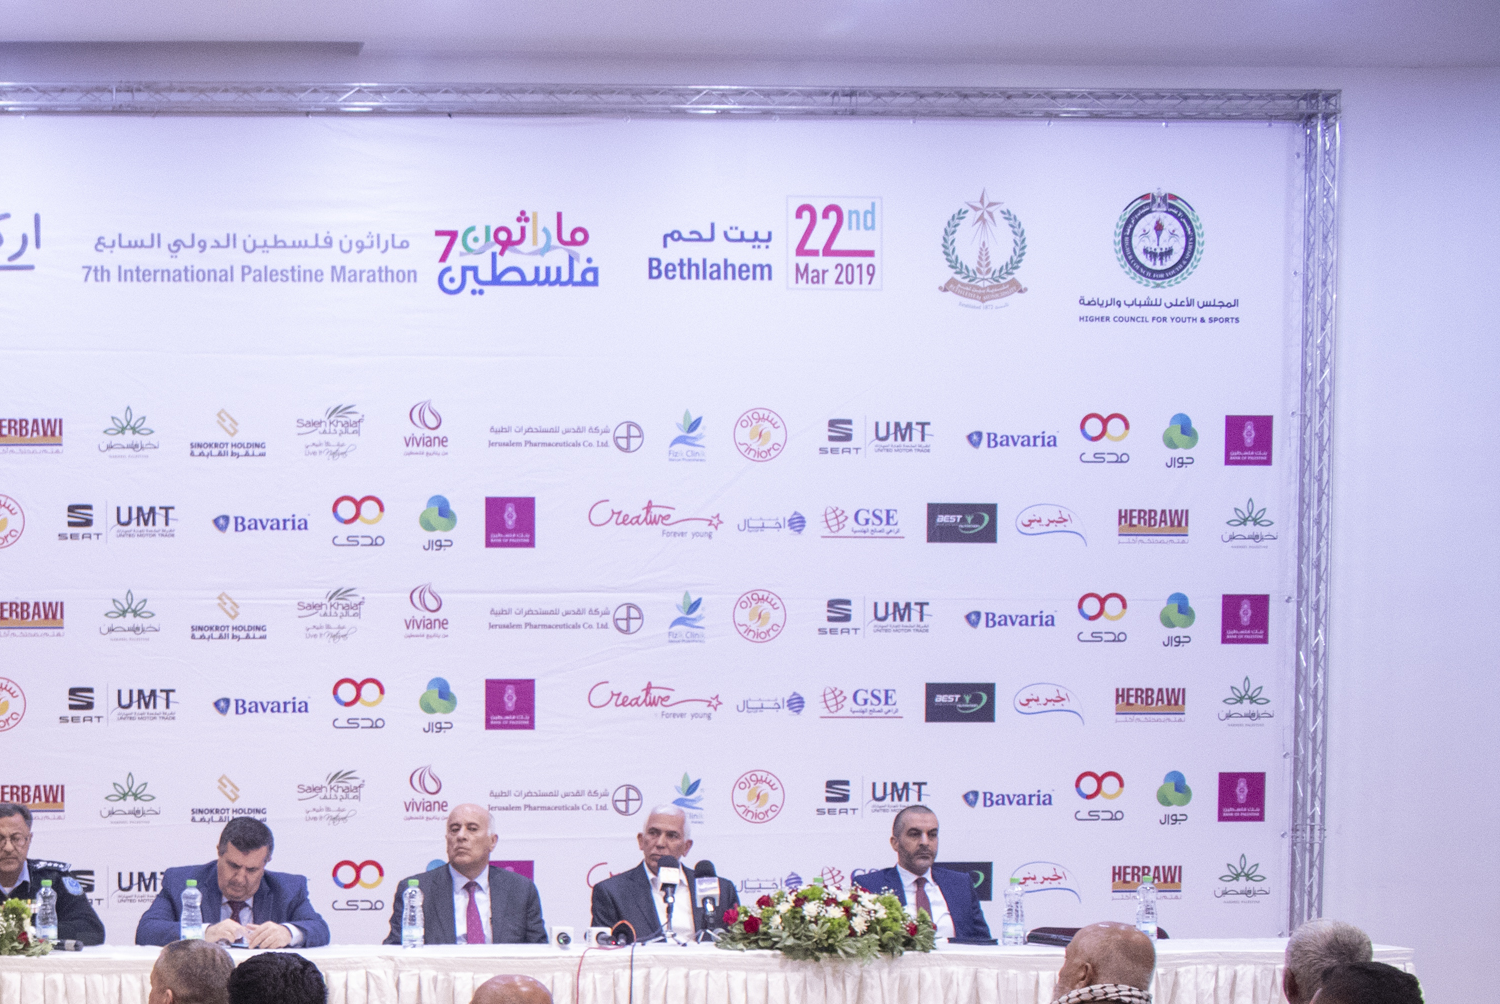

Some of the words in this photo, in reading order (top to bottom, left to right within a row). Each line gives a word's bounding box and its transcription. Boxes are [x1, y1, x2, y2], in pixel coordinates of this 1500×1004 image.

[242, 231, 333, 254] فلسطين
[339, 232, 410, 254] ماراثون
[462, 210, 589, 257] ماراثون
[662, 222, 715, 248] لحم
[723, 226, 772, 249] بيت
[94, 233, 162, 254] السابع
[167, 233, 237, 259] الدولي
[434, 230, 458, 263] 7
[81, 265, 111, 283] 7th
[117, 264, 235, 283] International
[241, 264, 324, 283] Palestine
[330, 264, 418, 283] Marathon
[438, 252, 599, 295] فلسطين
[648, 257, 773, 281] Bethlahem
[795, 263, 829, 285] Mar
[834, 263, 876, 285] 2019
[1079, 296, 1121, 308] والرياضة
[1124, 296, 1162, 308] للشباب
[1164, 297, 1195, 309] الأعلى
[1197, 299, 1239, 309] المجلس
[489, 425, 512, 435] الطبية
[514, 425, 560, 436] للمستحضرات
[561, 425, 586, 435] القدس
[588, 425, 610, 435] شركة
[874, 421, 931, 442] UMT
[986, 430, 1057, 449] Bavaria
[404, 433, 448, 448] viviane
[487, 440, 522, 449] Jerusalem
[524, 440, 580, 449] Pharmaceuticals
[582, 440, 594, 448] Co.
[596, 440, 610, 448] Ltd.
[819, 447, 861, 455] SEAT
[116, 505, 175, 528] UMT
[588, 499, 678, 528] Creative
[854, 509, 898, 526] GSE
[936, 514, 963, 523] BEST
[1117, 508, 1189, 527] HERBAWI
[233, 514, 308, 533] Bavaria
[873, 601, 929, 622] UMT
[985, 610, 1055, 628] Bavaria
[404, 616, 449, 630] viviane
[487, 622, 522, 631] Jerusalem
[524, 622, 580, 631] Pharmaceuticals
[582, 622, 594, 630] Co.
[596, 622, 610, 630] Ltd.
[117, 688, 176, 711] UMT
[588, 681, 677, 709] Creative
[852, 689, 896, 706] GSE
[934, 694, 961, 703] BEST
[1114, 687, 1186, 706] HERBAWI
[234, 697, 308, 716] Bavaria
[871, 781, 928, 802] UMT
[982, 789, 1053, 807] Bavaria
[404, 798, 448, 812] viviane
[487, 804, 522, 813] Jerusalem
[523, 804, 579, 813] Pharmaceuticals
[581, 804, 593, 812] Co.
[595, 804, 609, 812] Ltd.
[117, 871, 165, 892] UM
